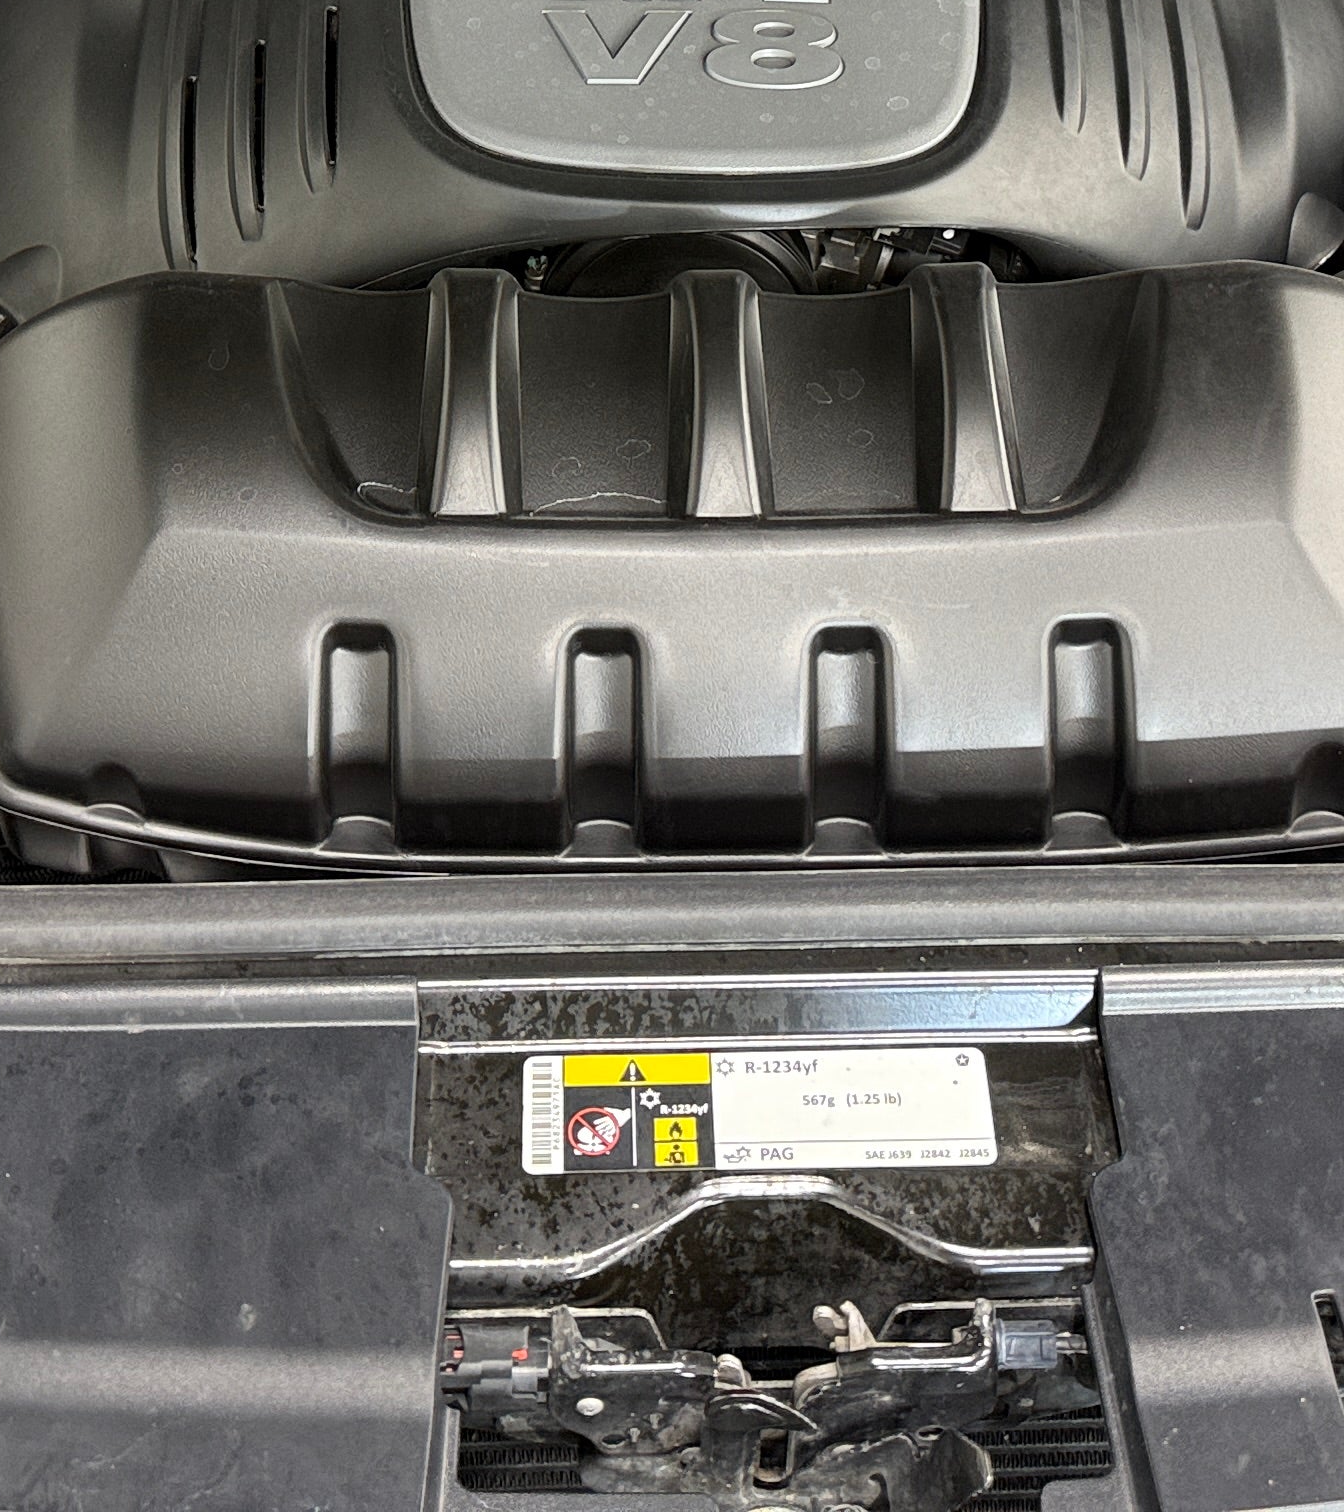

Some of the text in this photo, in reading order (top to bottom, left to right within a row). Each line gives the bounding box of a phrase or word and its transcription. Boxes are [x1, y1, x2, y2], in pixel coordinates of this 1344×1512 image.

[541, 9, 845, 90] V8
[745, 1059, 818, 1076] R-1234yf
[802, 1093, 902, 1108] 567g (1.25 lb)
[760, 1147, 794, 1162] PAG
[865, 1150, 885, 1160] SAE
[887, 1149, 912, 1160] J639
[920, 1149, 951, 1160] J2842
